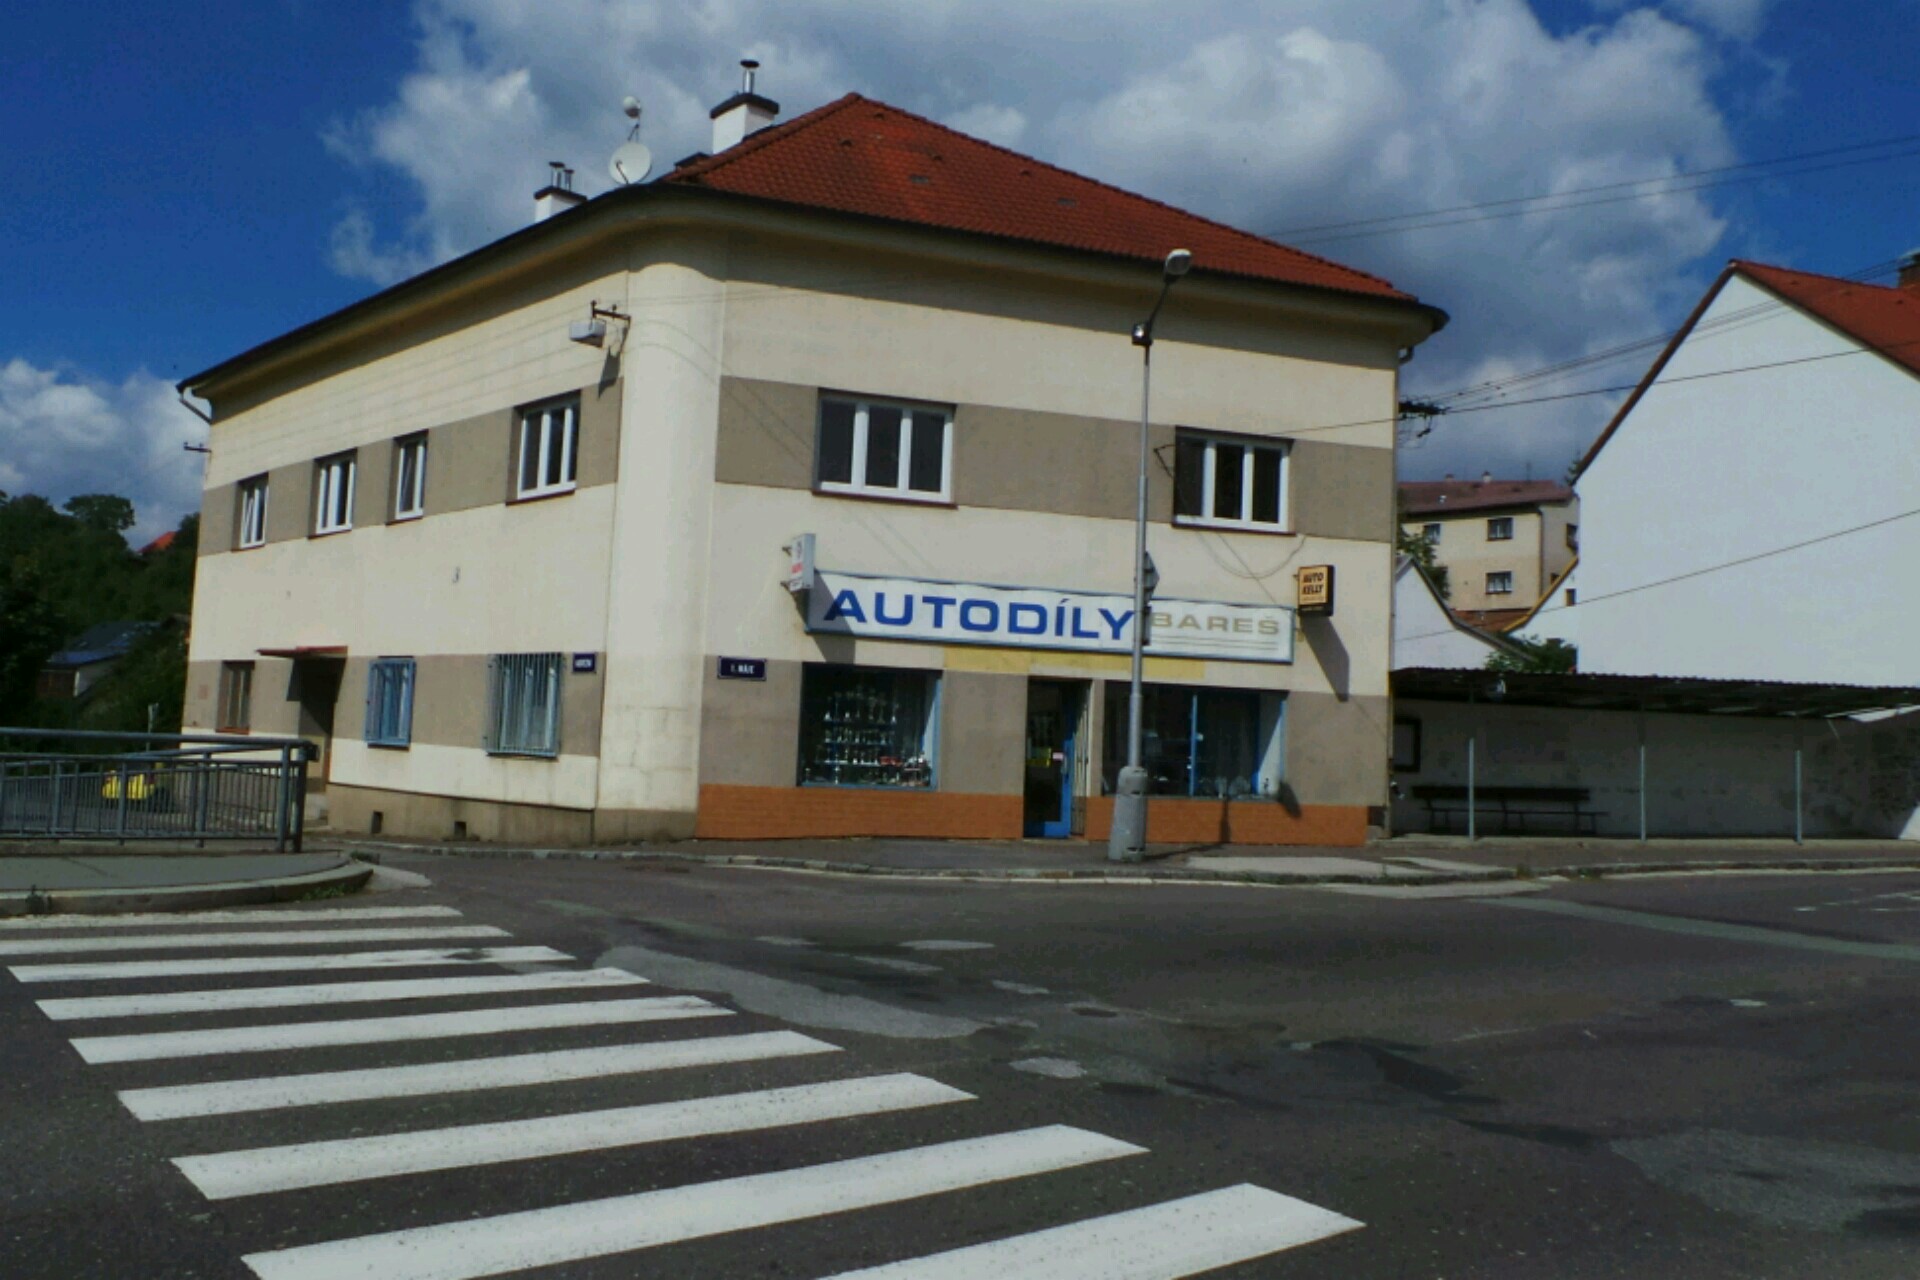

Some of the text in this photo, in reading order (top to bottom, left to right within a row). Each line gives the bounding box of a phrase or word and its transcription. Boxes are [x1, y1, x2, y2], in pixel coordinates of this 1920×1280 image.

[1303, 572, 1324, 583] AUTO
[1302, 584, 1323, 595] KELLY
[824, 589, 1280, 641] AUTODÍLY BAREŠ
